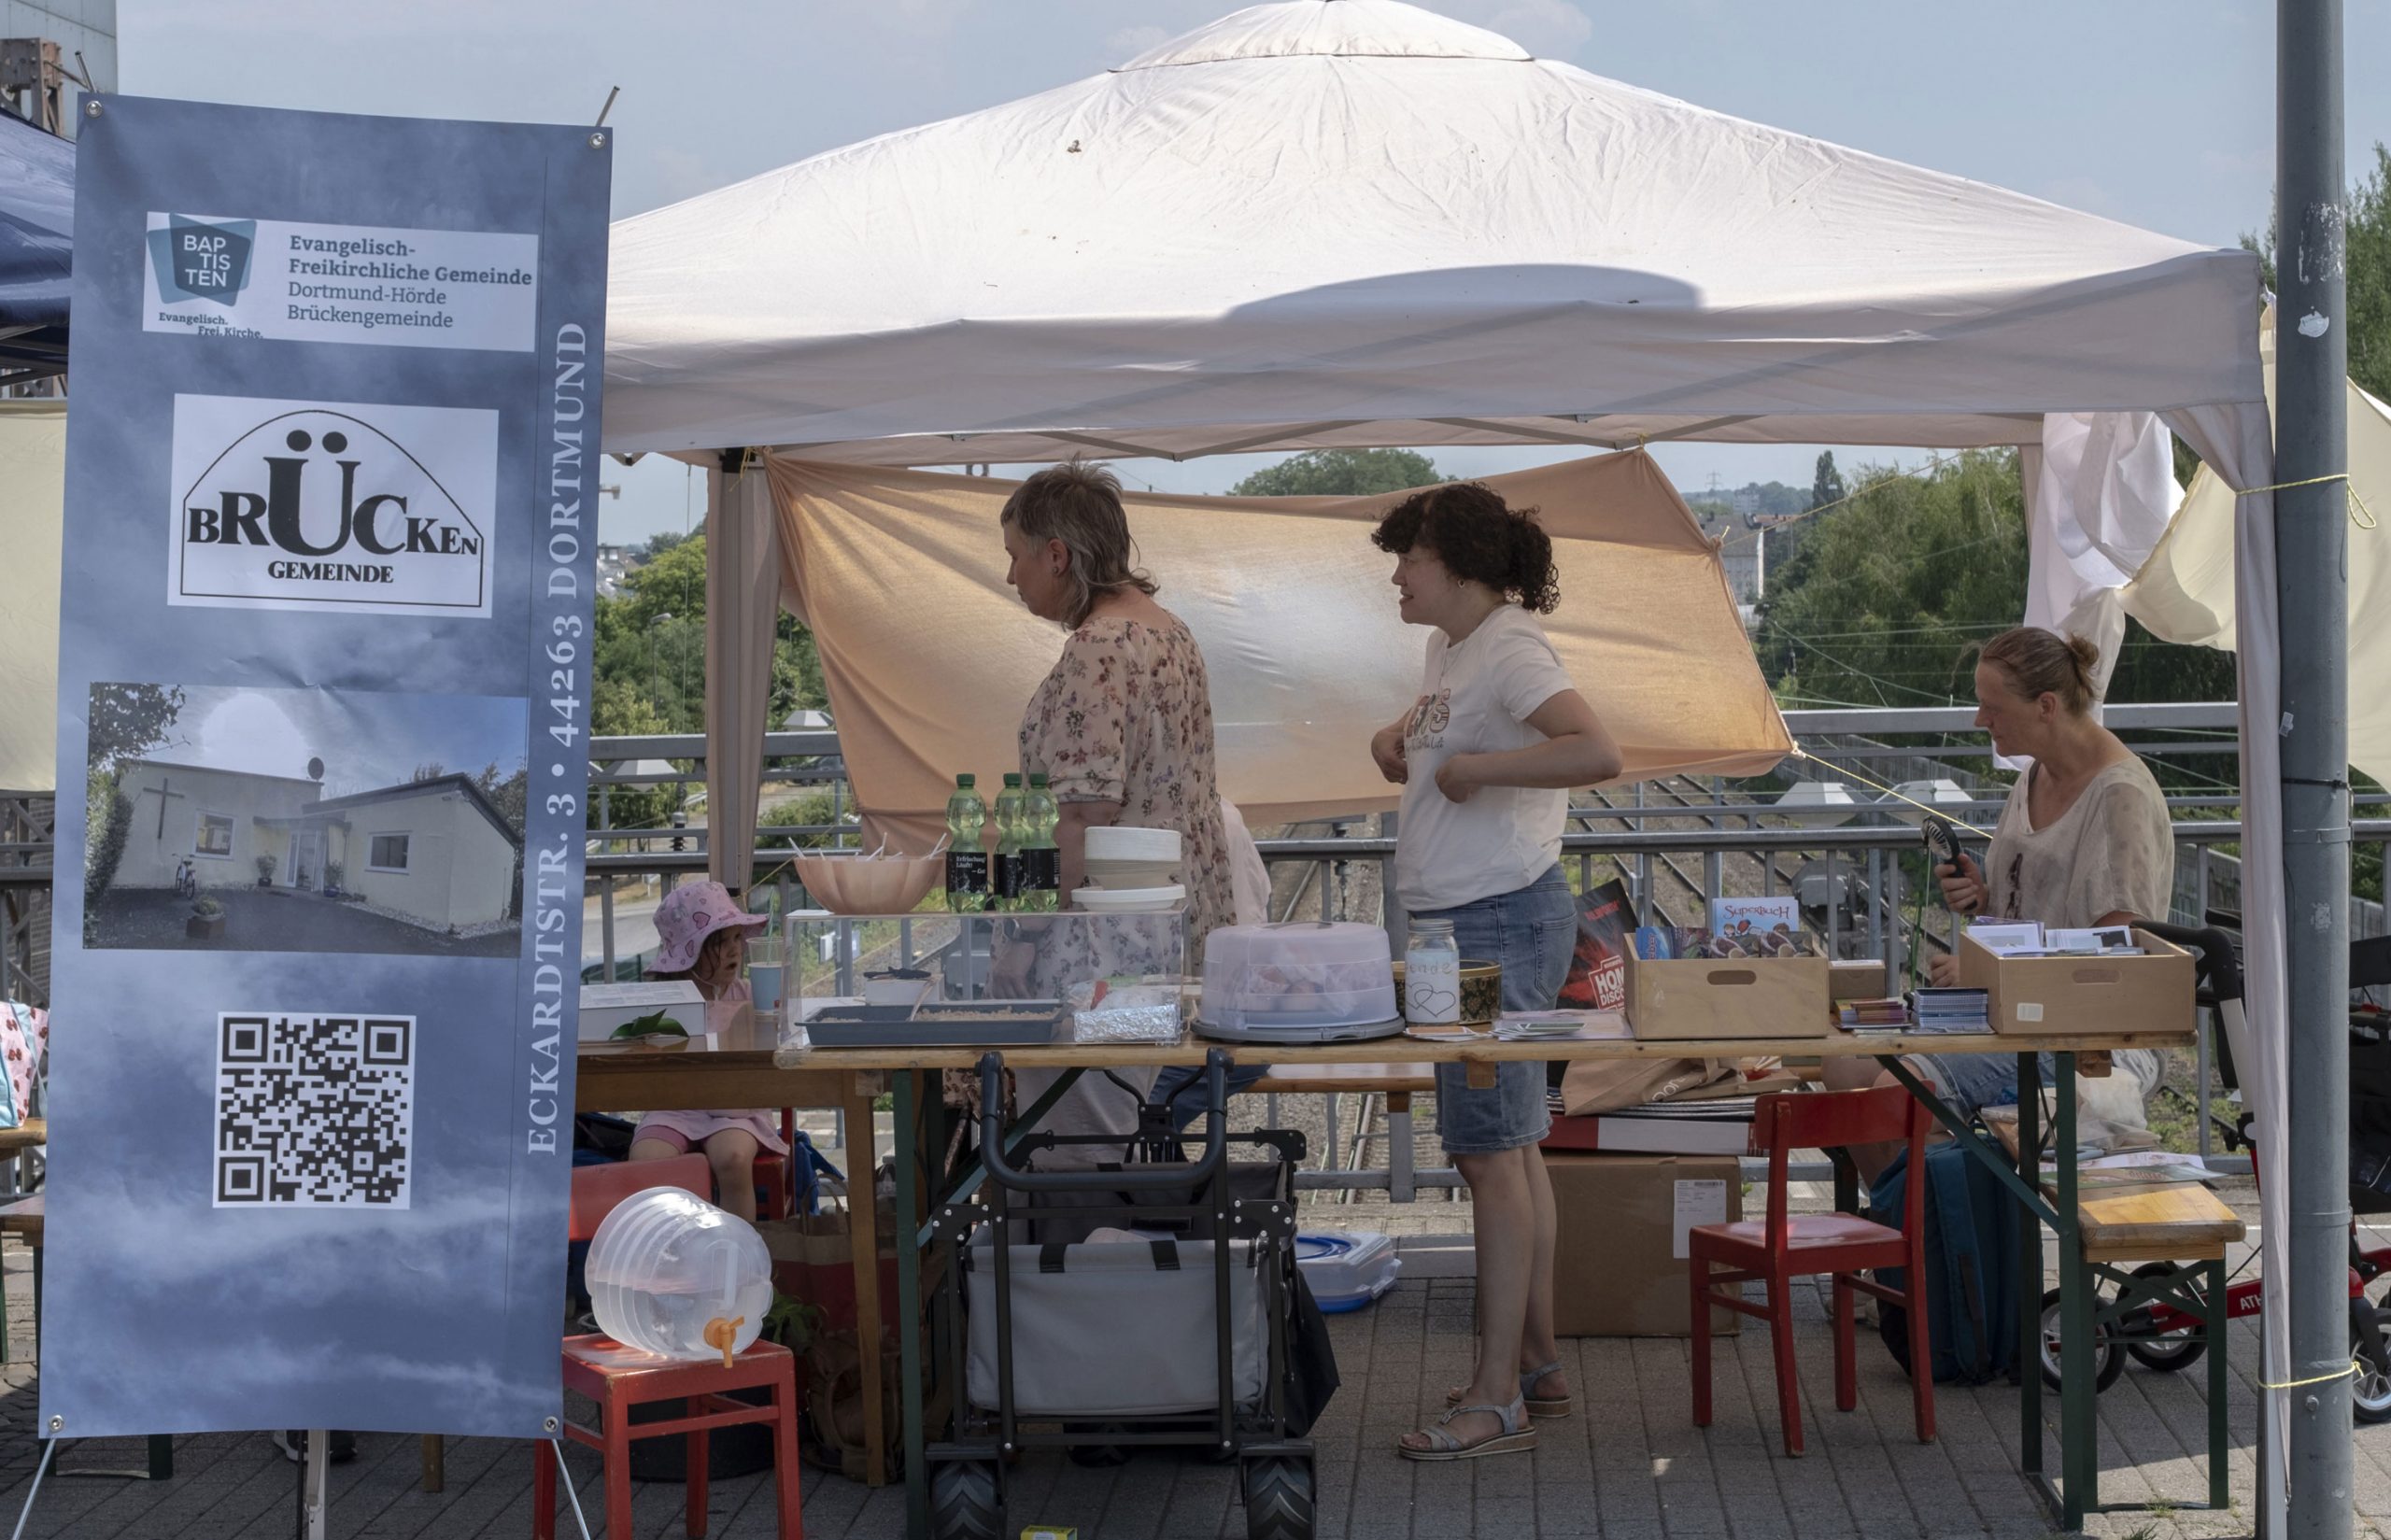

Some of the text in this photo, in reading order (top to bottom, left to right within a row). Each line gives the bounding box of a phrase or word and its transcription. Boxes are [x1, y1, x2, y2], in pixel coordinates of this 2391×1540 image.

[183, 234, 226, 252] BAP
[290, 234, 416, 258] Evangelisch-
[199, 253, 231, 270] TIS
[289, 258, 532, 285] Freikirchliche Gemeinde
[185, 269, 227, 287] TEN
[289, 281, 446, 304] Dortmund-Hörde
[159, 312, 229, 325] Evangelisch.
[287, 304, 453, 328] Brückengemeinde
[547, 323, 587, 600] DORTMUND
[267, 560, 394, 584] GEMEINDE
[545, 615, 582, 747] 44263
[546, 793, 576, 817] 3
[528, 832, 569, 1155] ECKARDTSTR.
